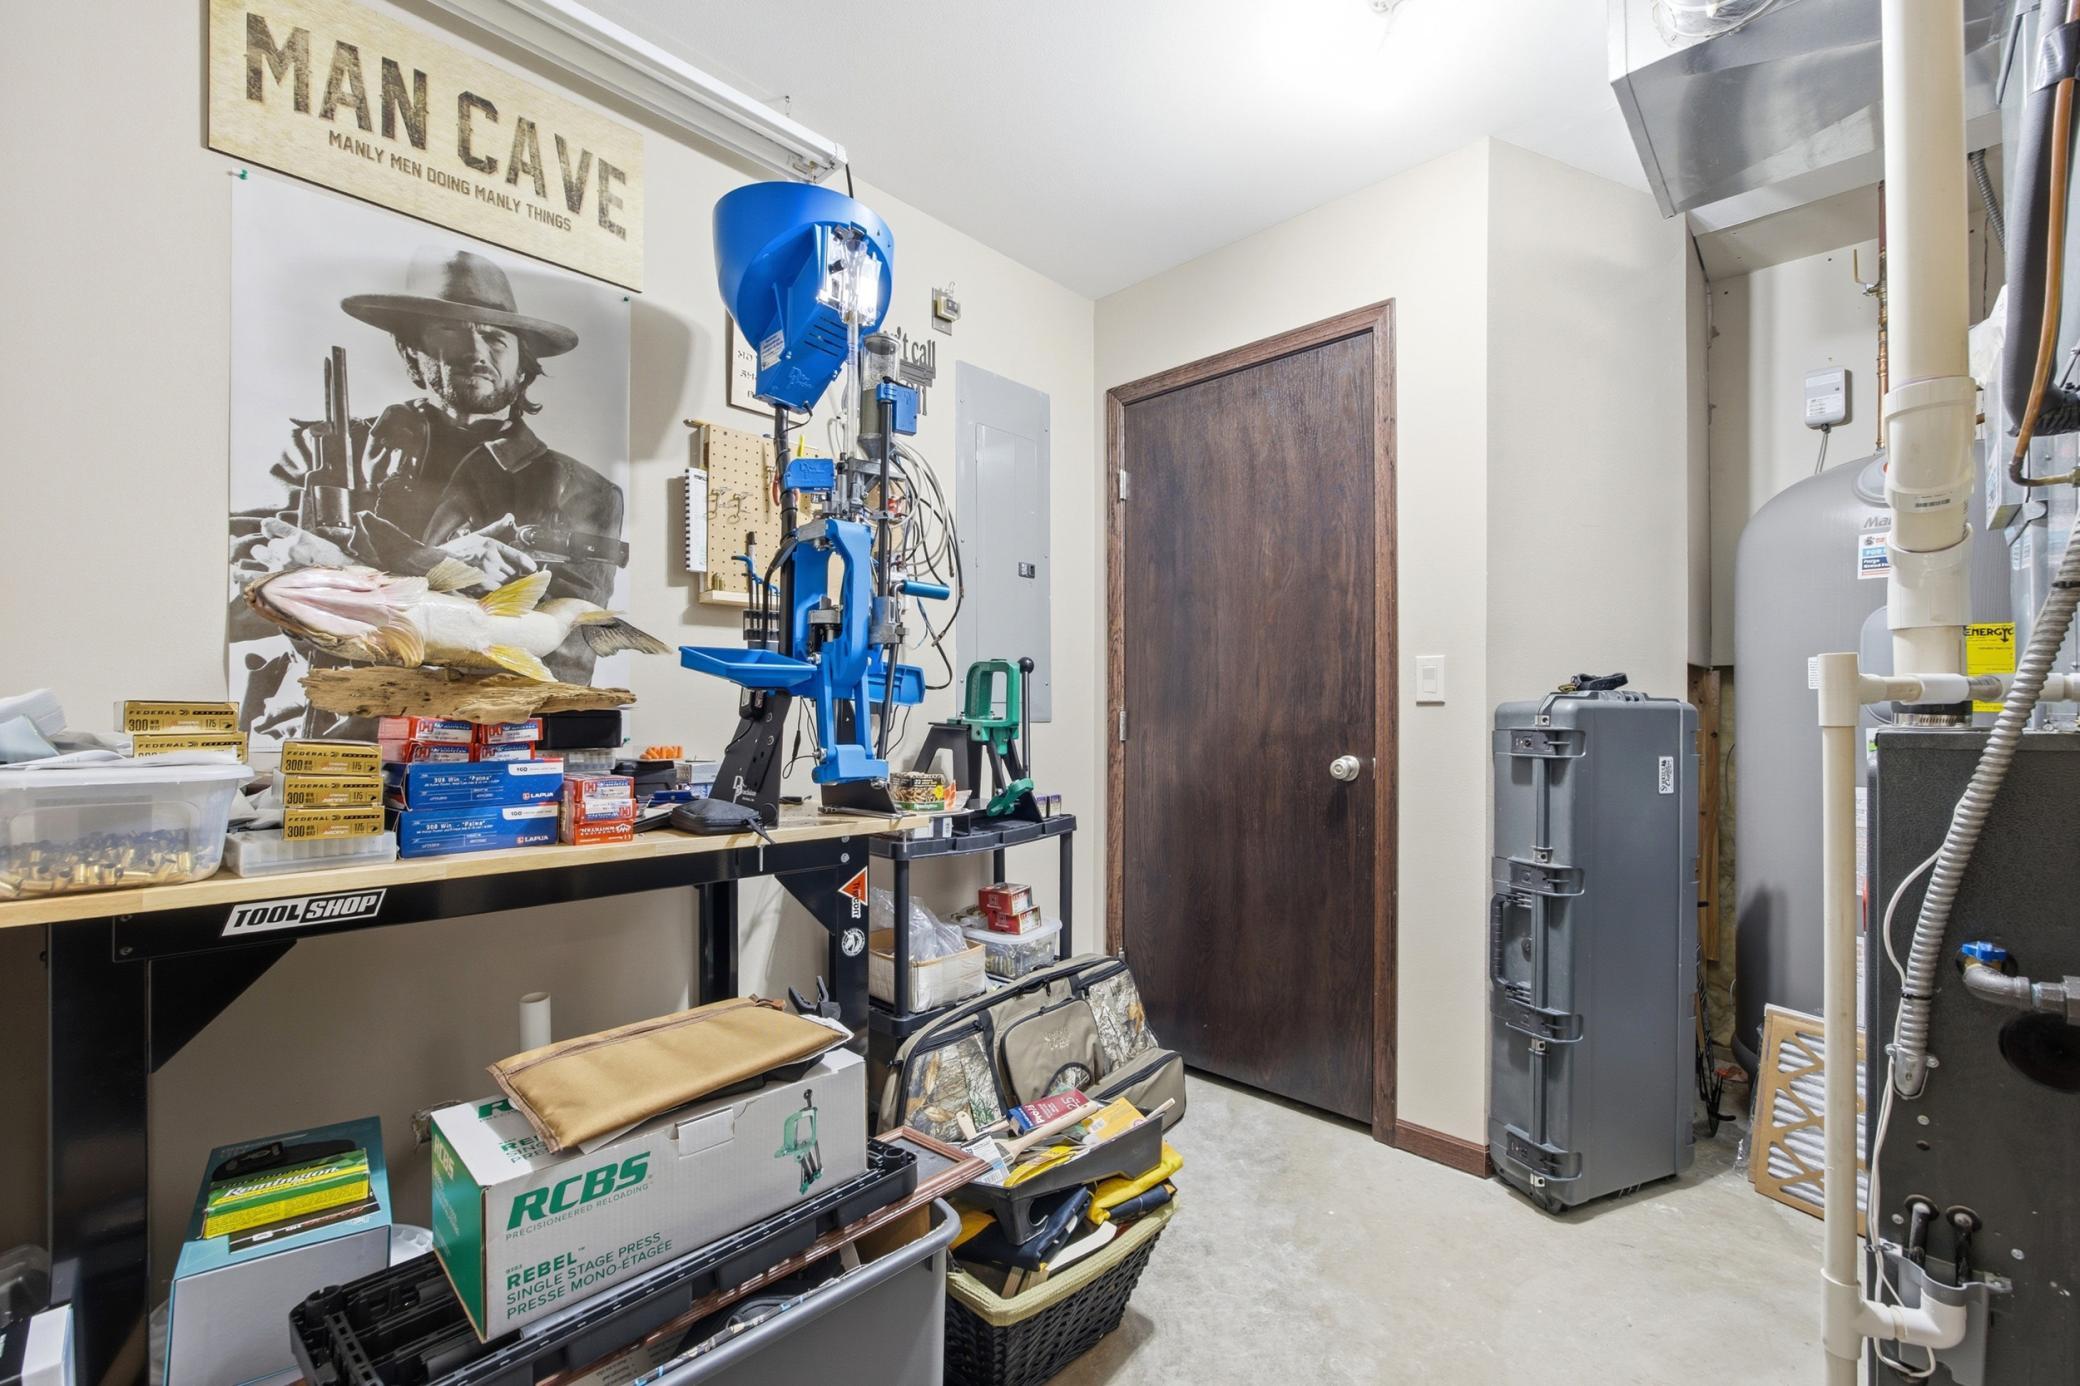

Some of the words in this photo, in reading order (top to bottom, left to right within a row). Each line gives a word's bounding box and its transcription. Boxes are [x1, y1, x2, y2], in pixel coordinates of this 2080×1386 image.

[245, 11, 428, 150] MAN
[456, 90, 627, 241] CAVE
[328, 129, 384, 164] MANLY
[390, 153, 422, 178] MEN
[427, 167, 471, 196] DOING
[474, 184, 521, 213] MANLY
[526, 203, 572, 232] THINGS
[911, 339, 936, 370] call
[128, 719, 149, 732] 300
[205, 719, 217, 728] 175
[285, 759, 303, 771] 300
[287, 792, 304, 804] 300
[287, 825, 305, 838] 300
[525, 835, 549, 843] LAPUA
[233, 904, 300, 928] TOOL
[305, 894, 378, 919] SHOP
[223, 1167, 340, 1198] Remington
[507, 1151, 651, 1231] RCBS
[505, 1204, 593, 1241] PRECISIONEERED
[596, 1184, 649, 1209] RELOADING
[506, 1273, 563, 1306] SINGLE
[567, 1251, 614, 1281] STAGE
[618, 1232, 661, 1259] PRESS
[506, 1286, 566, 1320] PRESSE
[570, 1239, 673, 1293] MONO-ÉTAGÉE
